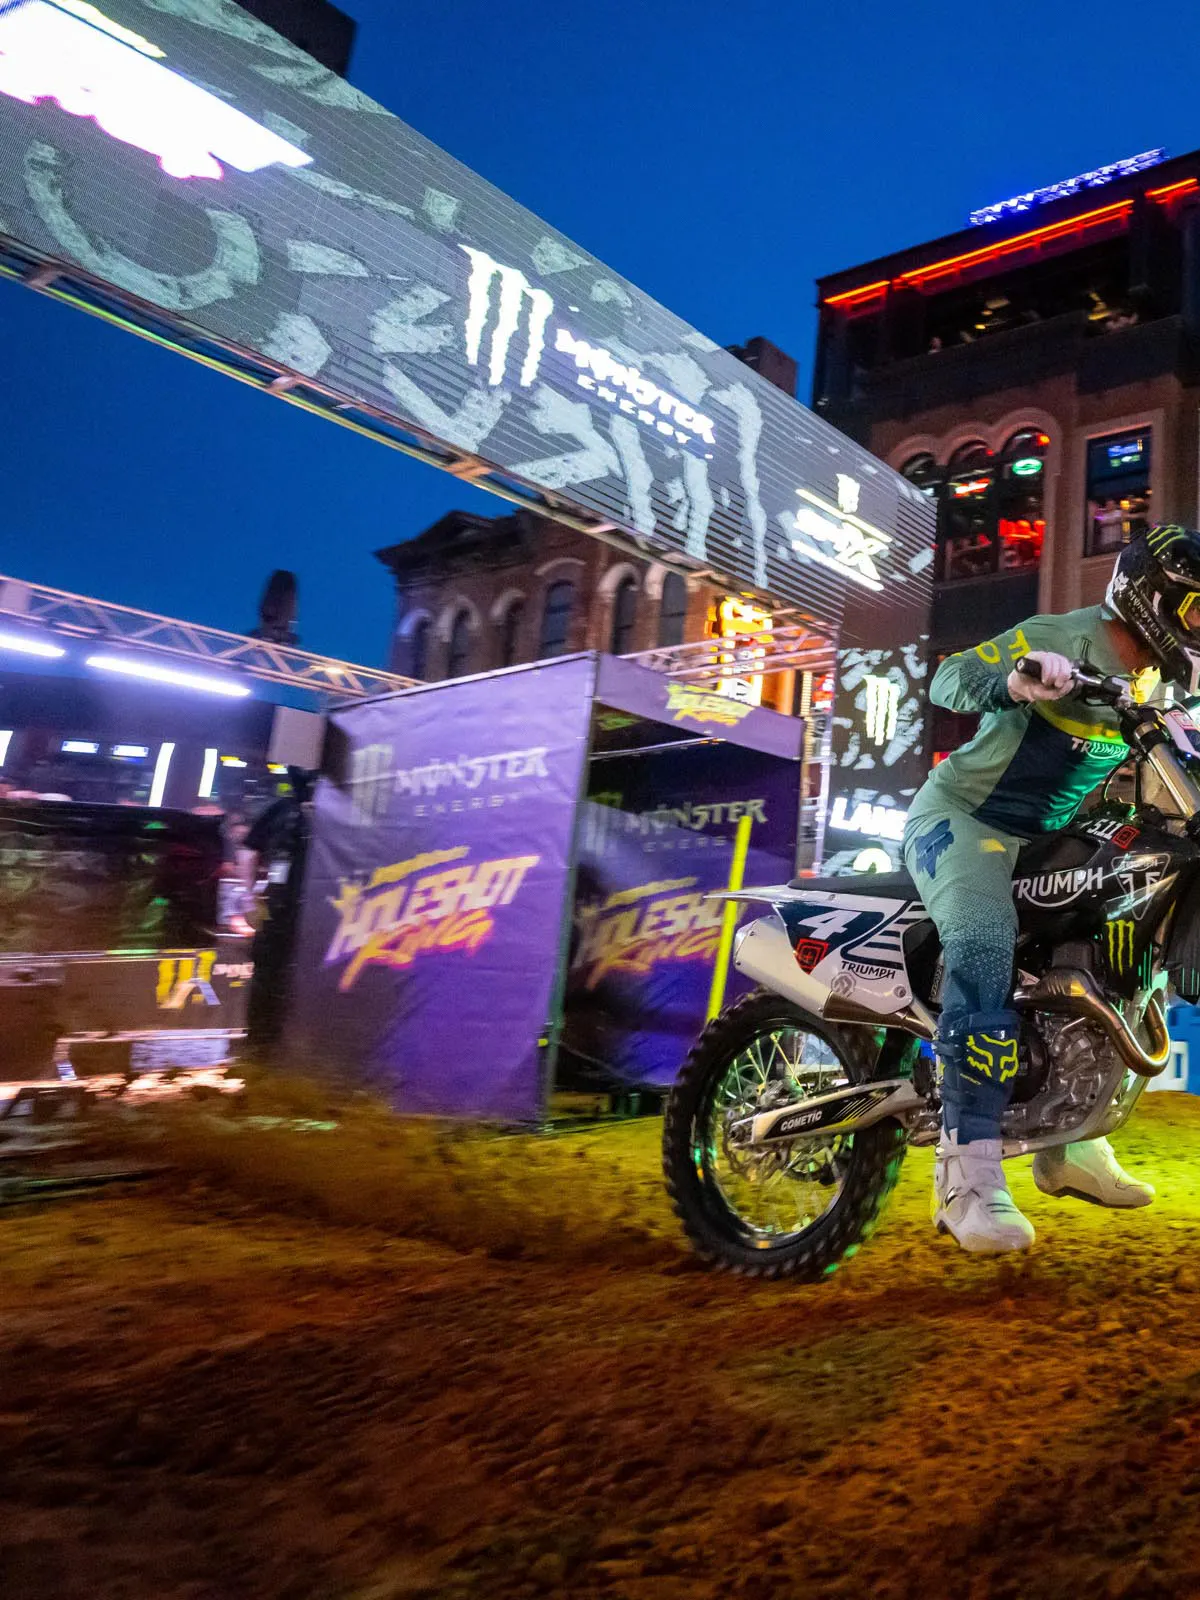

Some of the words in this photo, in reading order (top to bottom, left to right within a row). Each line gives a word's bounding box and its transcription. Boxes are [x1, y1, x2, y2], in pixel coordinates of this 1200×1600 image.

[1071, 736, 1130, 760] TRIUMPH
[394, 747, 549, 796] MONSTER
[1085, 818, 1124, 841] 5.11
[1011, 866, 1103, 899] TRIUMPH
[841, 960, 896, 979] TRIUMPH
[781, 1110, 822, 1132] COMETIC
